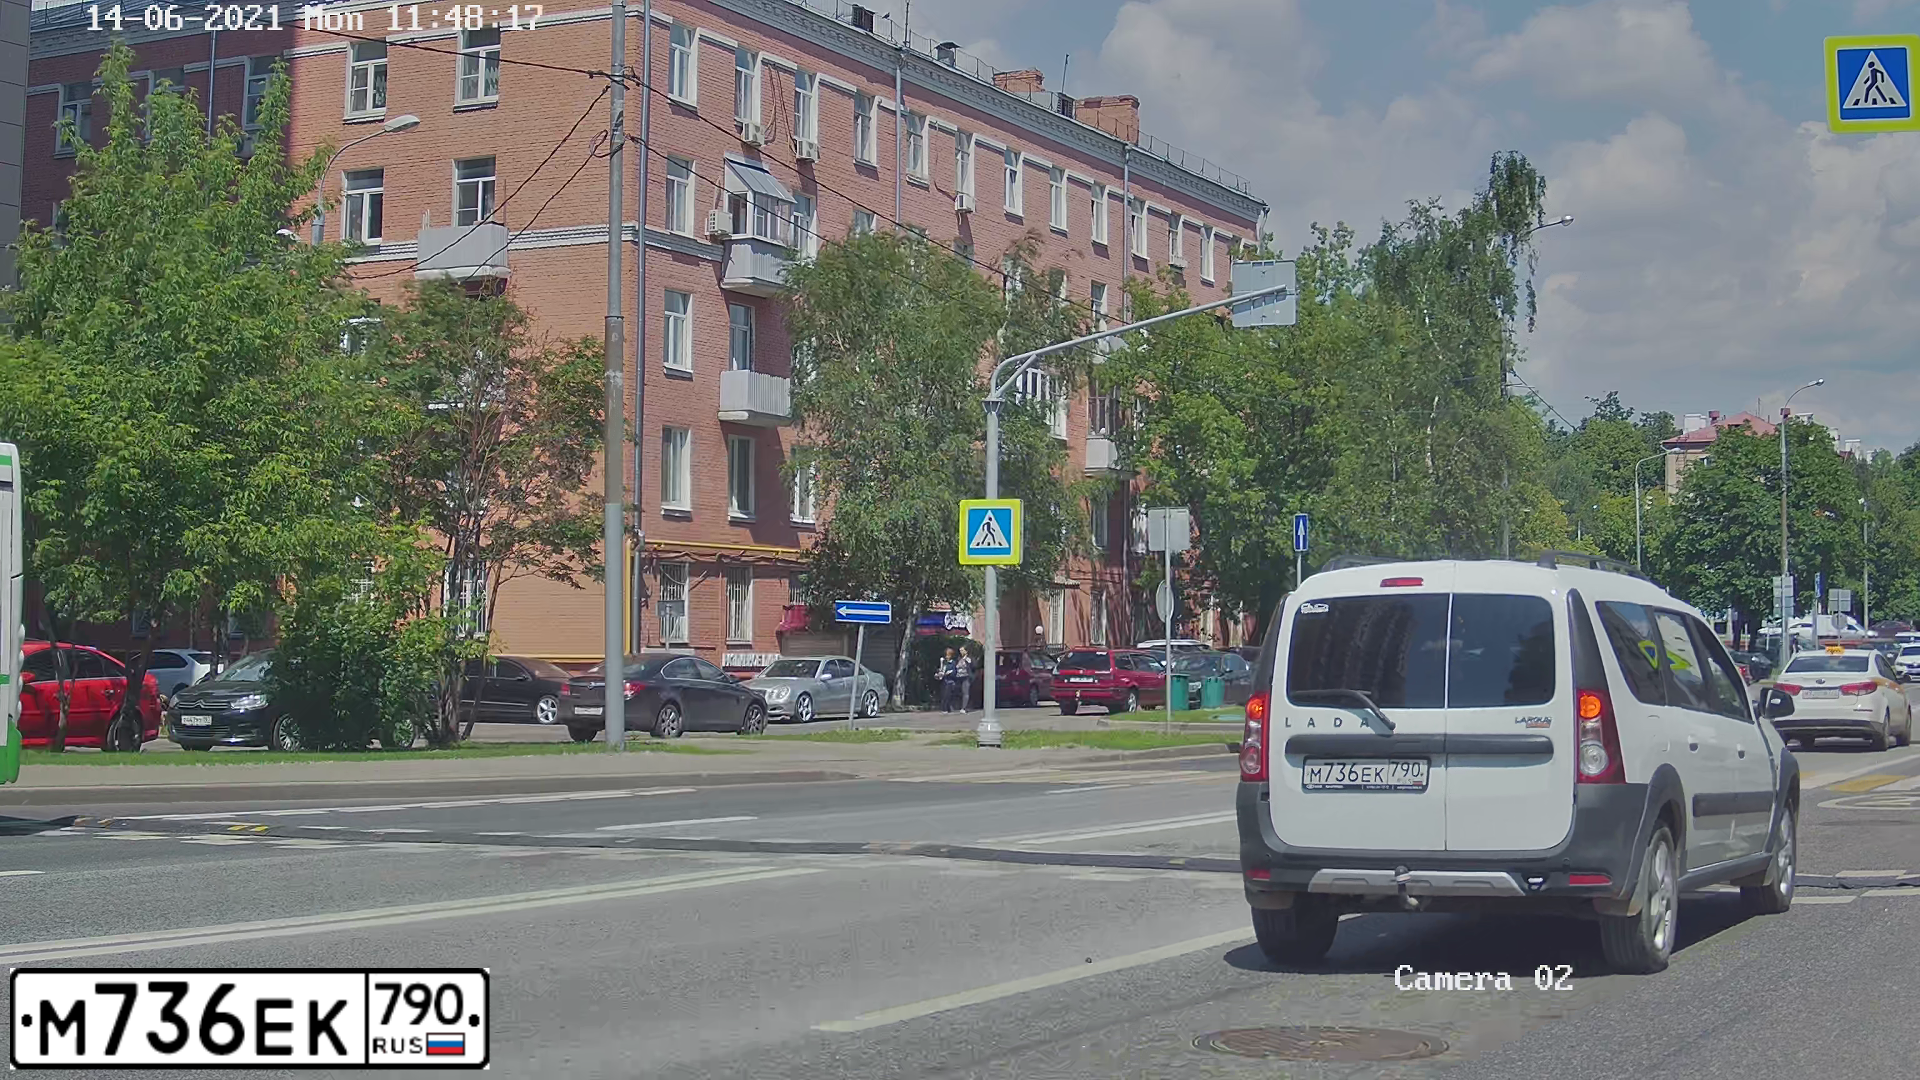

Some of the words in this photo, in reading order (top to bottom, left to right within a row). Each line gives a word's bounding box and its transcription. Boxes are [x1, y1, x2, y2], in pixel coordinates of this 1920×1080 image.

[1285, 717, 1370, 728] LADA
[1310, 762, 1385, 783] М736ЕК
[1391, 761, 1421, 777] 790
